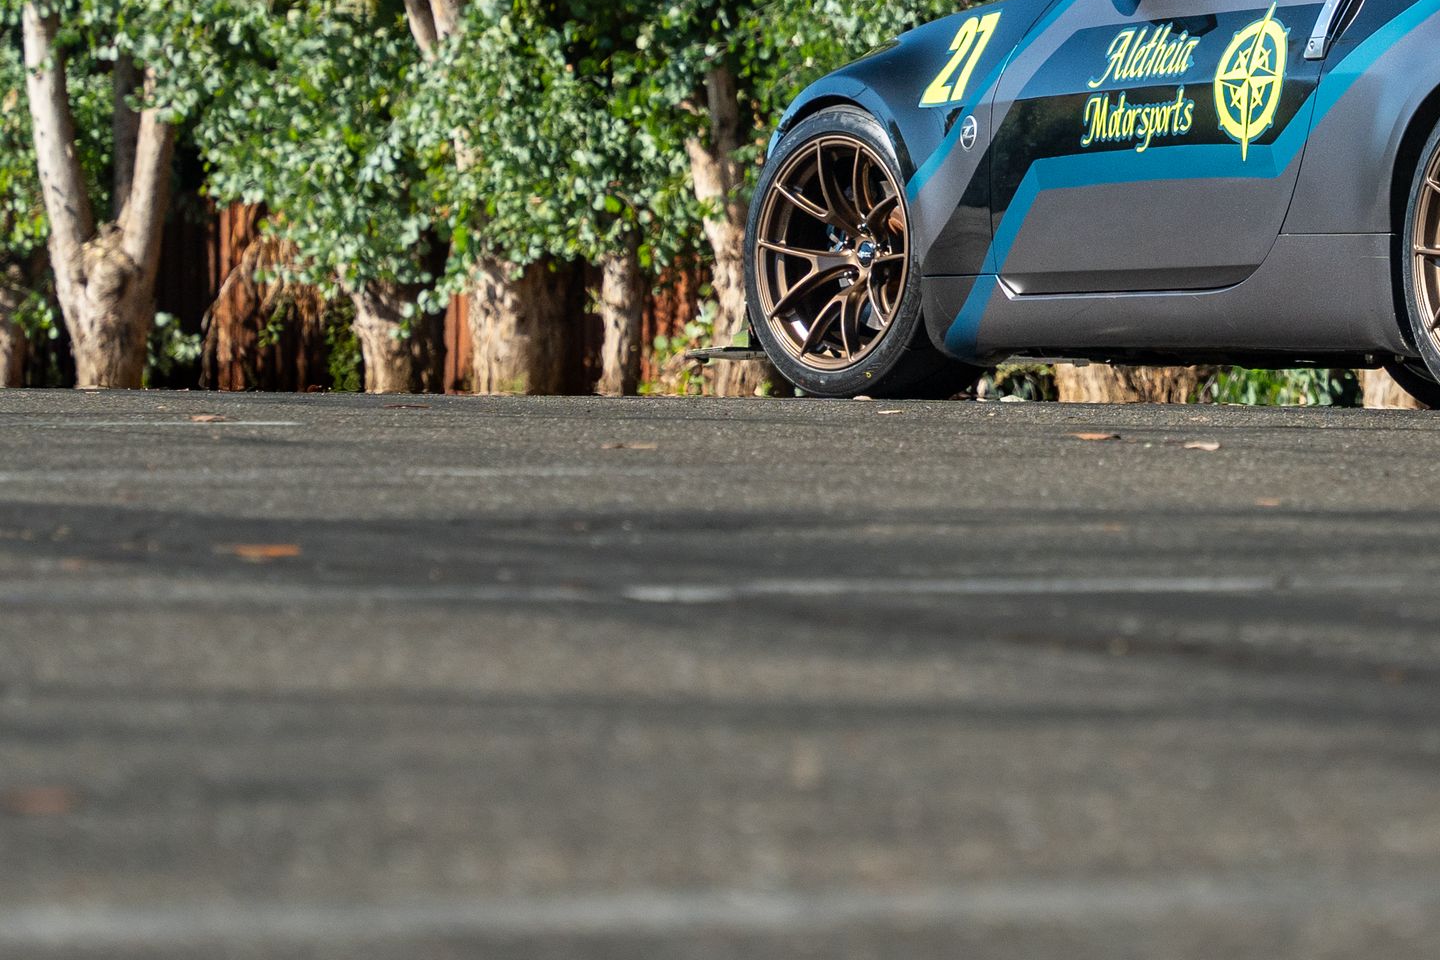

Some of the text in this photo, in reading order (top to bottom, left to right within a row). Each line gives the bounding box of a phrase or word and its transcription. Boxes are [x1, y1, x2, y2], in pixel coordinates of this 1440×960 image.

[921, 11, 1002, 104] 27
[1088, 23, 1199, 88] Aletheia
[1082, 89, 1192, 152] Motorsports
